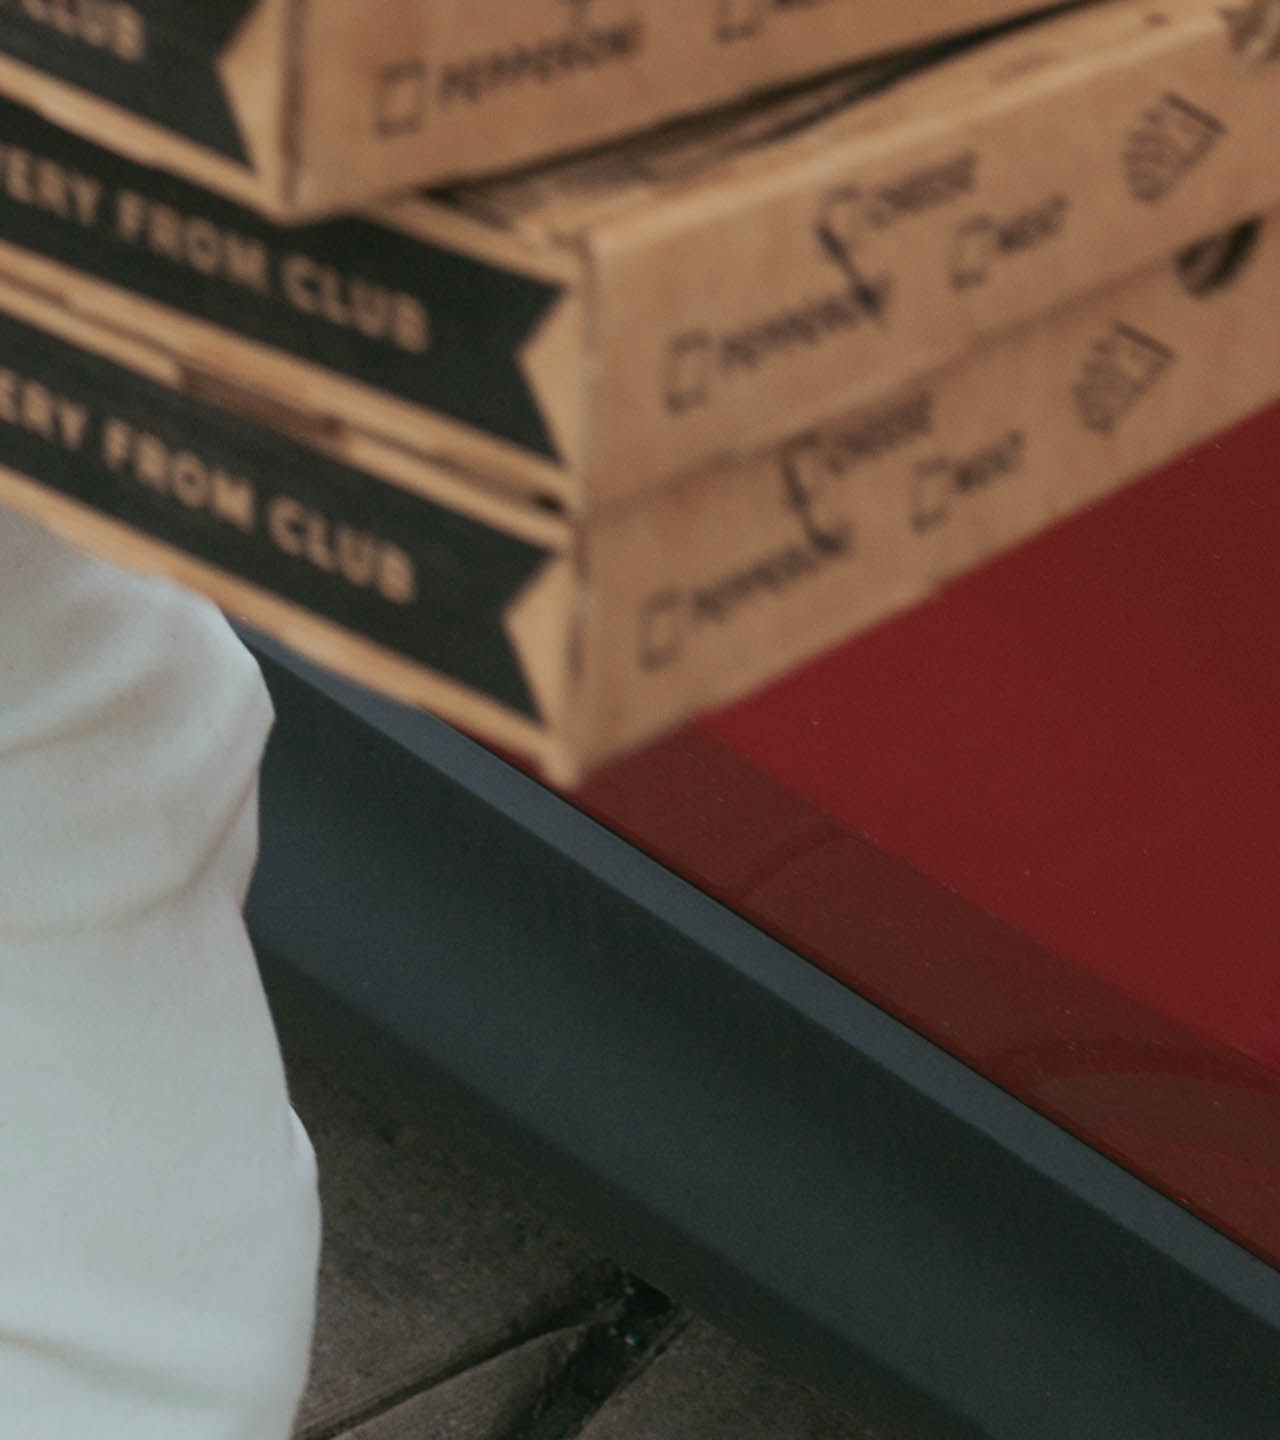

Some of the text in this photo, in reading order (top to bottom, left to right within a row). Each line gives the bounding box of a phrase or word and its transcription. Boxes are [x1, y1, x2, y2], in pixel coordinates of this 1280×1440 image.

[116, 189, 270, 296] FROM
[281, 252, 429, 354] CLUB
[103, 417, 254, 534] FROM
[266, 494, 415, 605] CLUB
